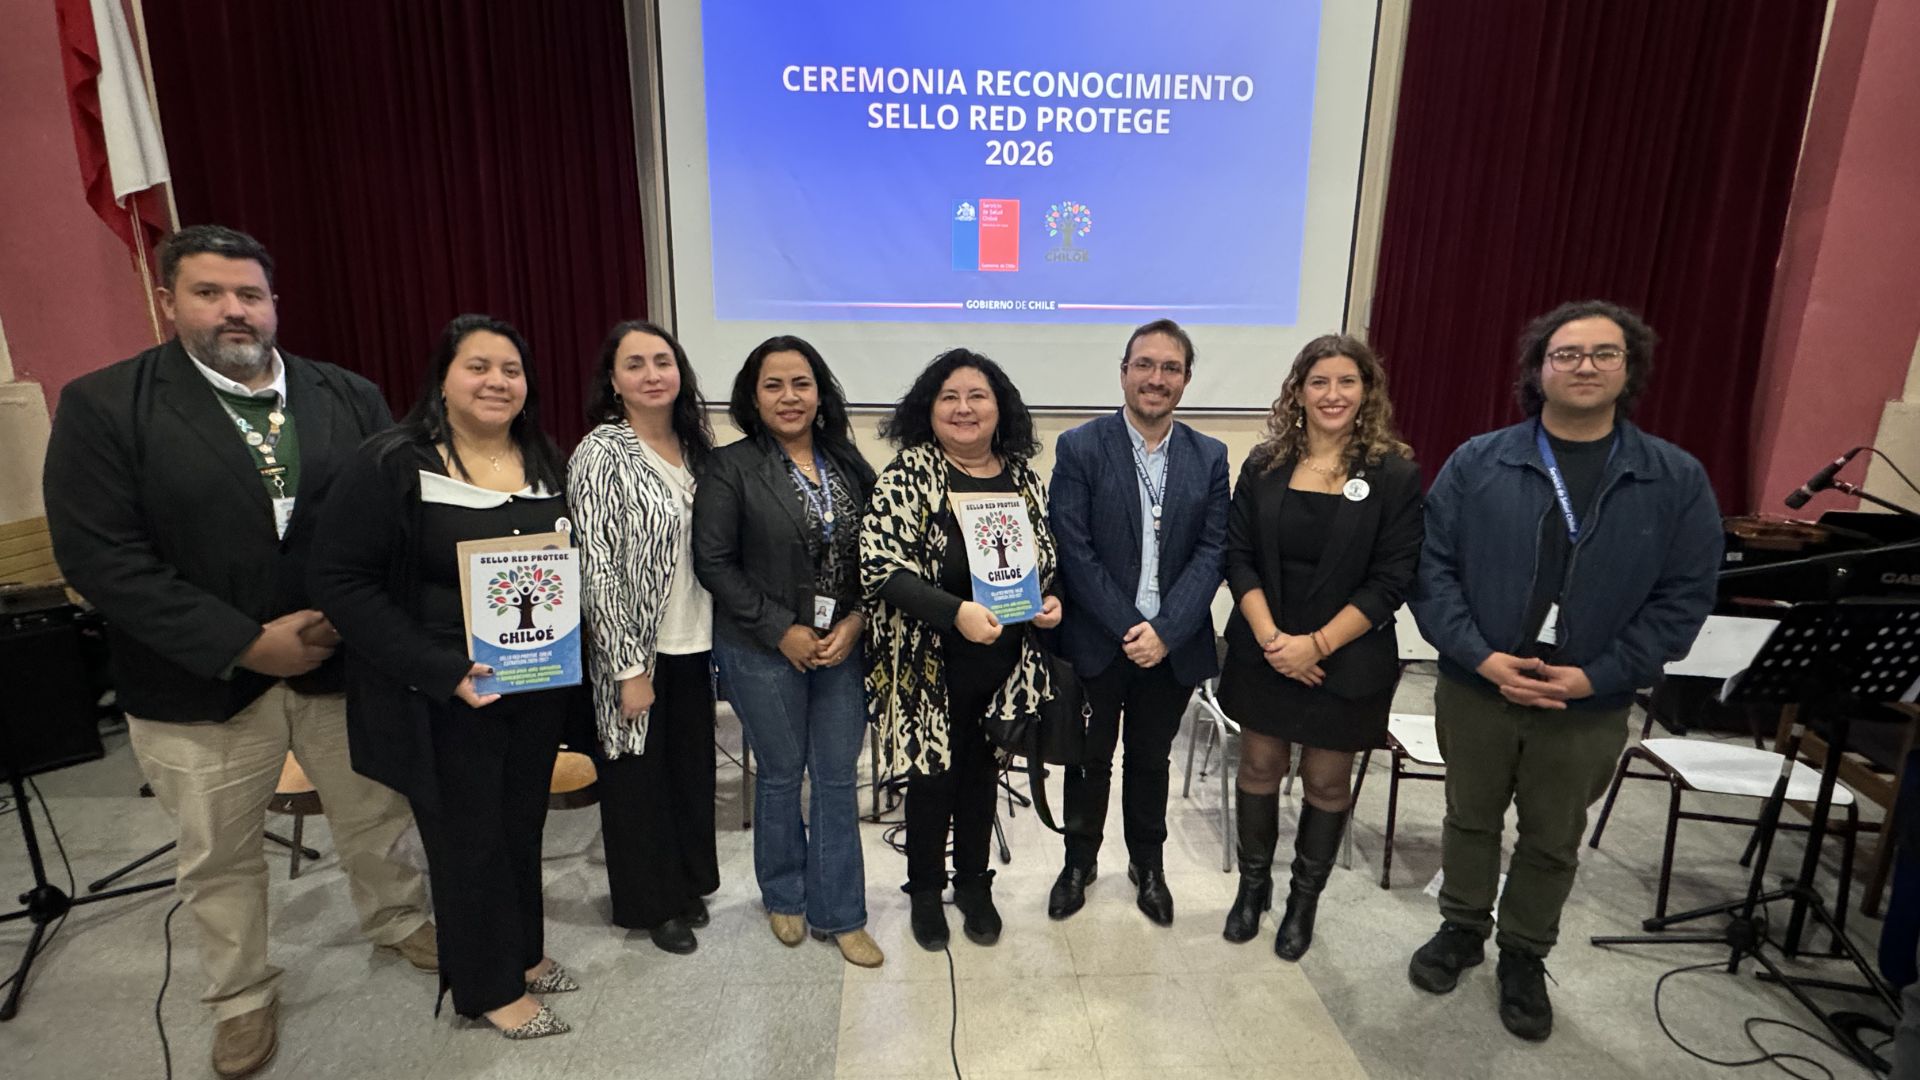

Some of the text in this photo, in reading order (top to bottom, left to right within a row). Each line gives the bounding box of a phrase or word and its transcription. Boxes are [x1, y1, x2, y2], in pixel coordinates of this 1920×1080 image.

[782, 65, 1254, 102] CEREMONIA RECONOCIMIENTO
[867, 102, 1171, 134] SELLO RED PROTEGE
[985, 139, 1054, 167] 2026
[966, 299, 1056, 310] GOBIERNO DE CHILE
[480, 553, 569, 564] SELLO RED PROTEGE
[988, 564, 1022, 582] CHILOÉ
[499, 624, 554, 645] CHILOÉ
